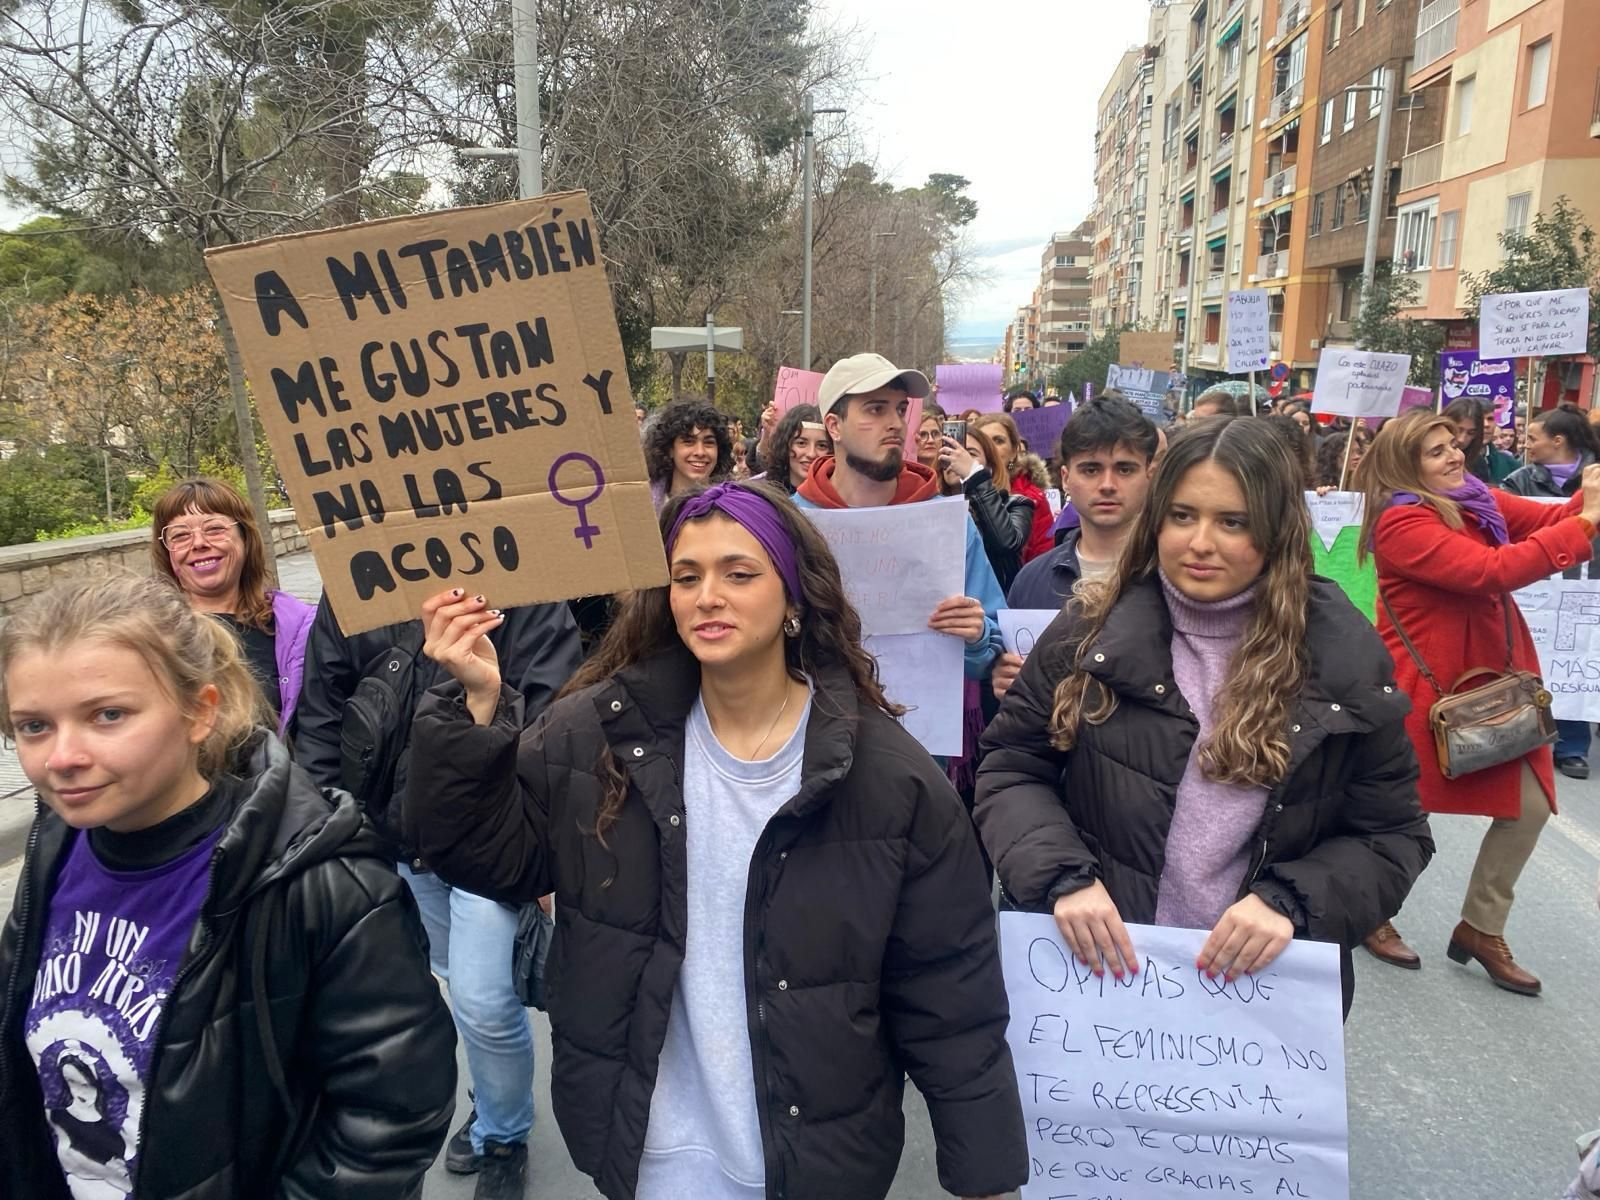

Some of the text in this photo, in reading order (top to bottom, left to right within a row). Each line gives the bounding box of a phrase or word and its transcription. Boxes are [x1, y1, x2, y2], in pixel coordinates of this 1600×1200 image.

[254, 207, 596, 336] A MI TAMBIÉN
[271, 317, 554, 423] ME GUSTAN
[294, 370, 613, 476] LAS MUJERES Y
[312, 461, 502, 539] NO LAS
[350, 526, 519, 600] ACOSO
[73, 911, 150, 965] NI UN
[32, 953, 81, 1009] PASO
[1028, 1014, 1328, 1072] EL FEMINISMO NO
[1027, 1073, 1074, 1104] TE
[1036, 1117, 1295, 1164] PERO TE OLVIDAS
[1032, 1157, 1311, 1197] DE QUE GRACIAS AL
